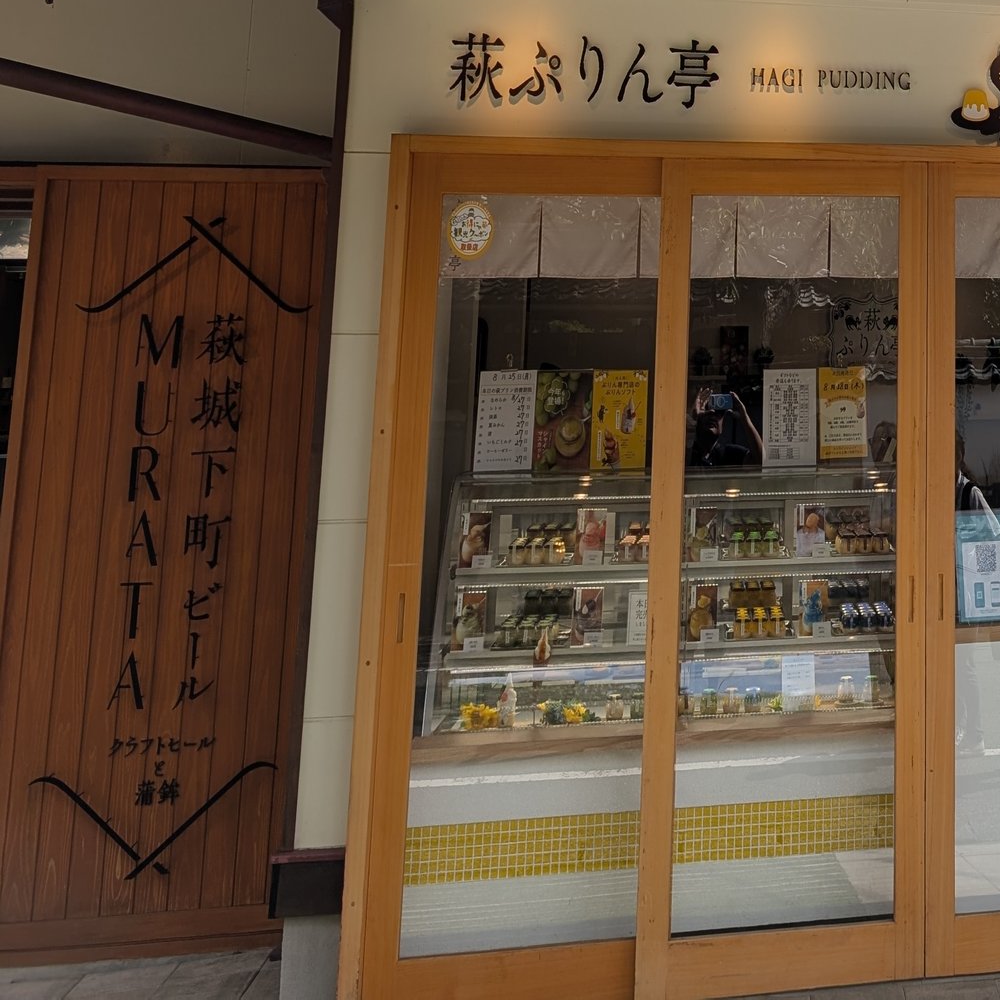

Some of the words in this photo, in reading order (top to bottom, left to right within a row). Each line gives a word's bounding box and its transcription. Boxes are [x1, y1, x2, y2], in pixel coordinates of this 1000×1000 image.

[451, 33, 720, 109] 萩ぷりん亭
[750, 67, 803, 91] HAGI
[818, 69, 912, 92] PUDDING
[864, 308, 881, 332] 萩
[107, 314, 184, 711] MURATA
[173, 313, 246, 710] 萩城下町ビール
[154, 760, 166, 777] と
